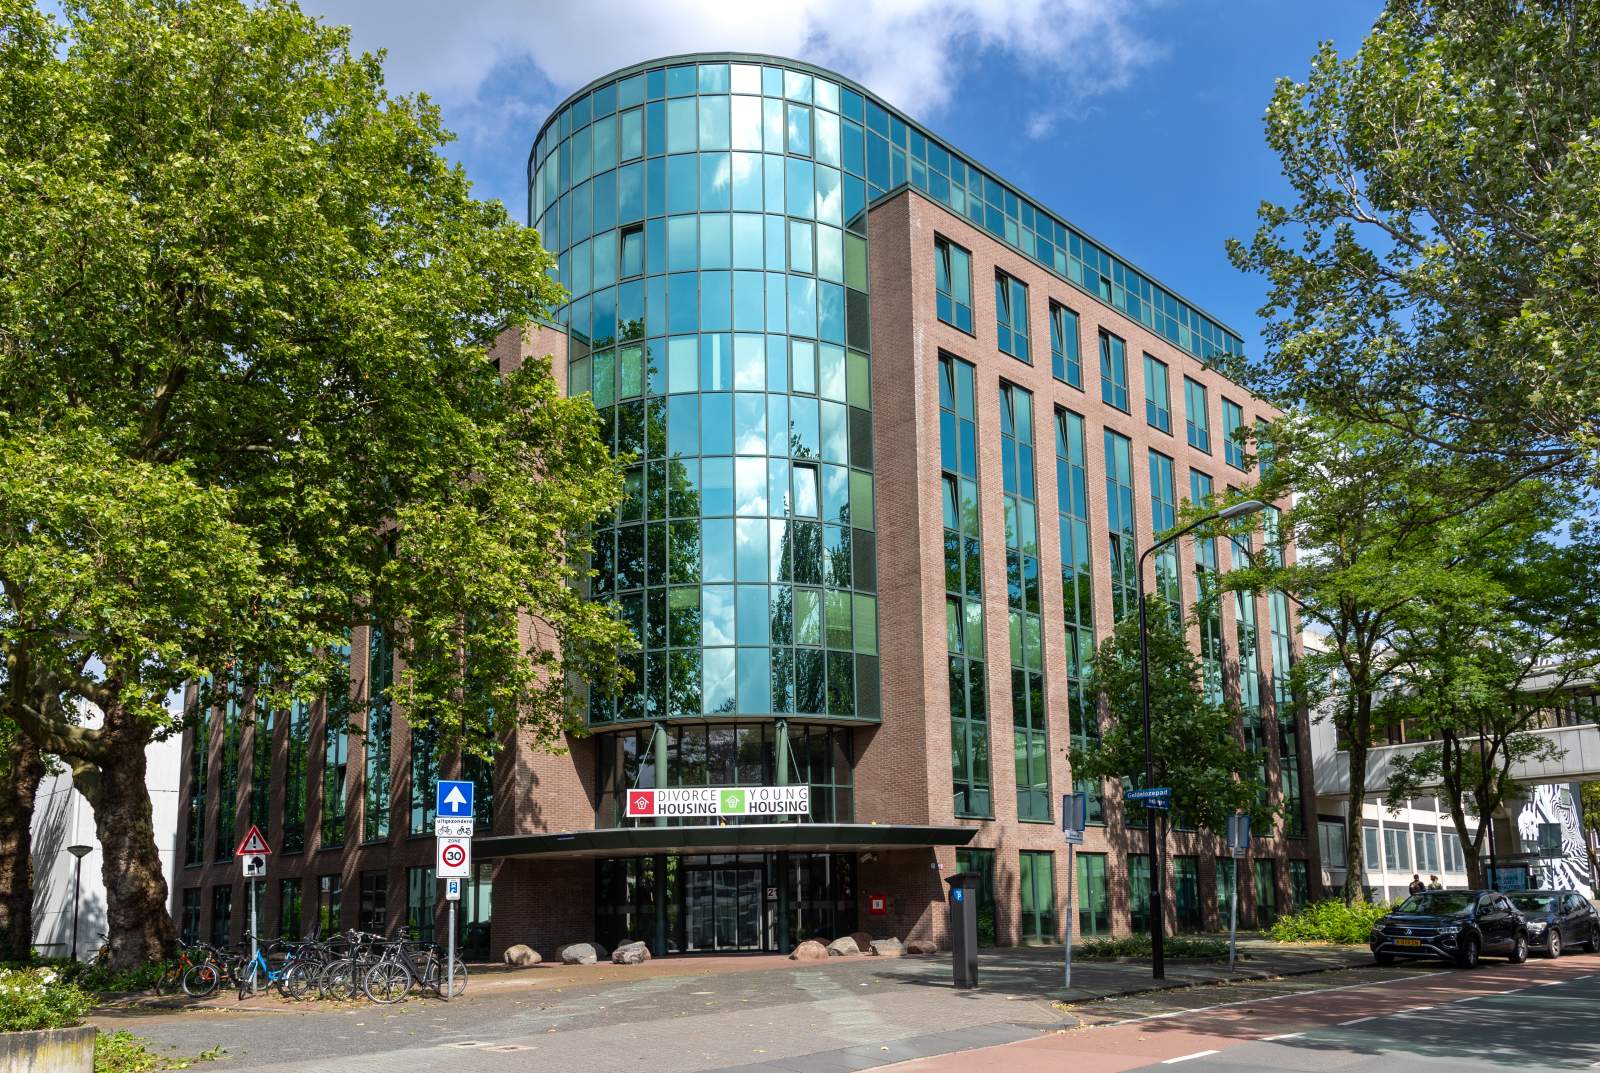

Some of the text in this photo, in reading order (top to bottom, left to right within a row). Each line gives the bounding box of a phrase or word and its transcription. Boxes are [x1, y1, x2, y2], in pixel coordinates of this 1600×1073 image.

[658, 790, 716, 802] DIVORCE
[749, 788, 808, 800] YOUNG
[658, 803, 717, 815] HOUSING
[749, 801, 808, 813] HOUSING
[447, 851, 461, 861] 30
